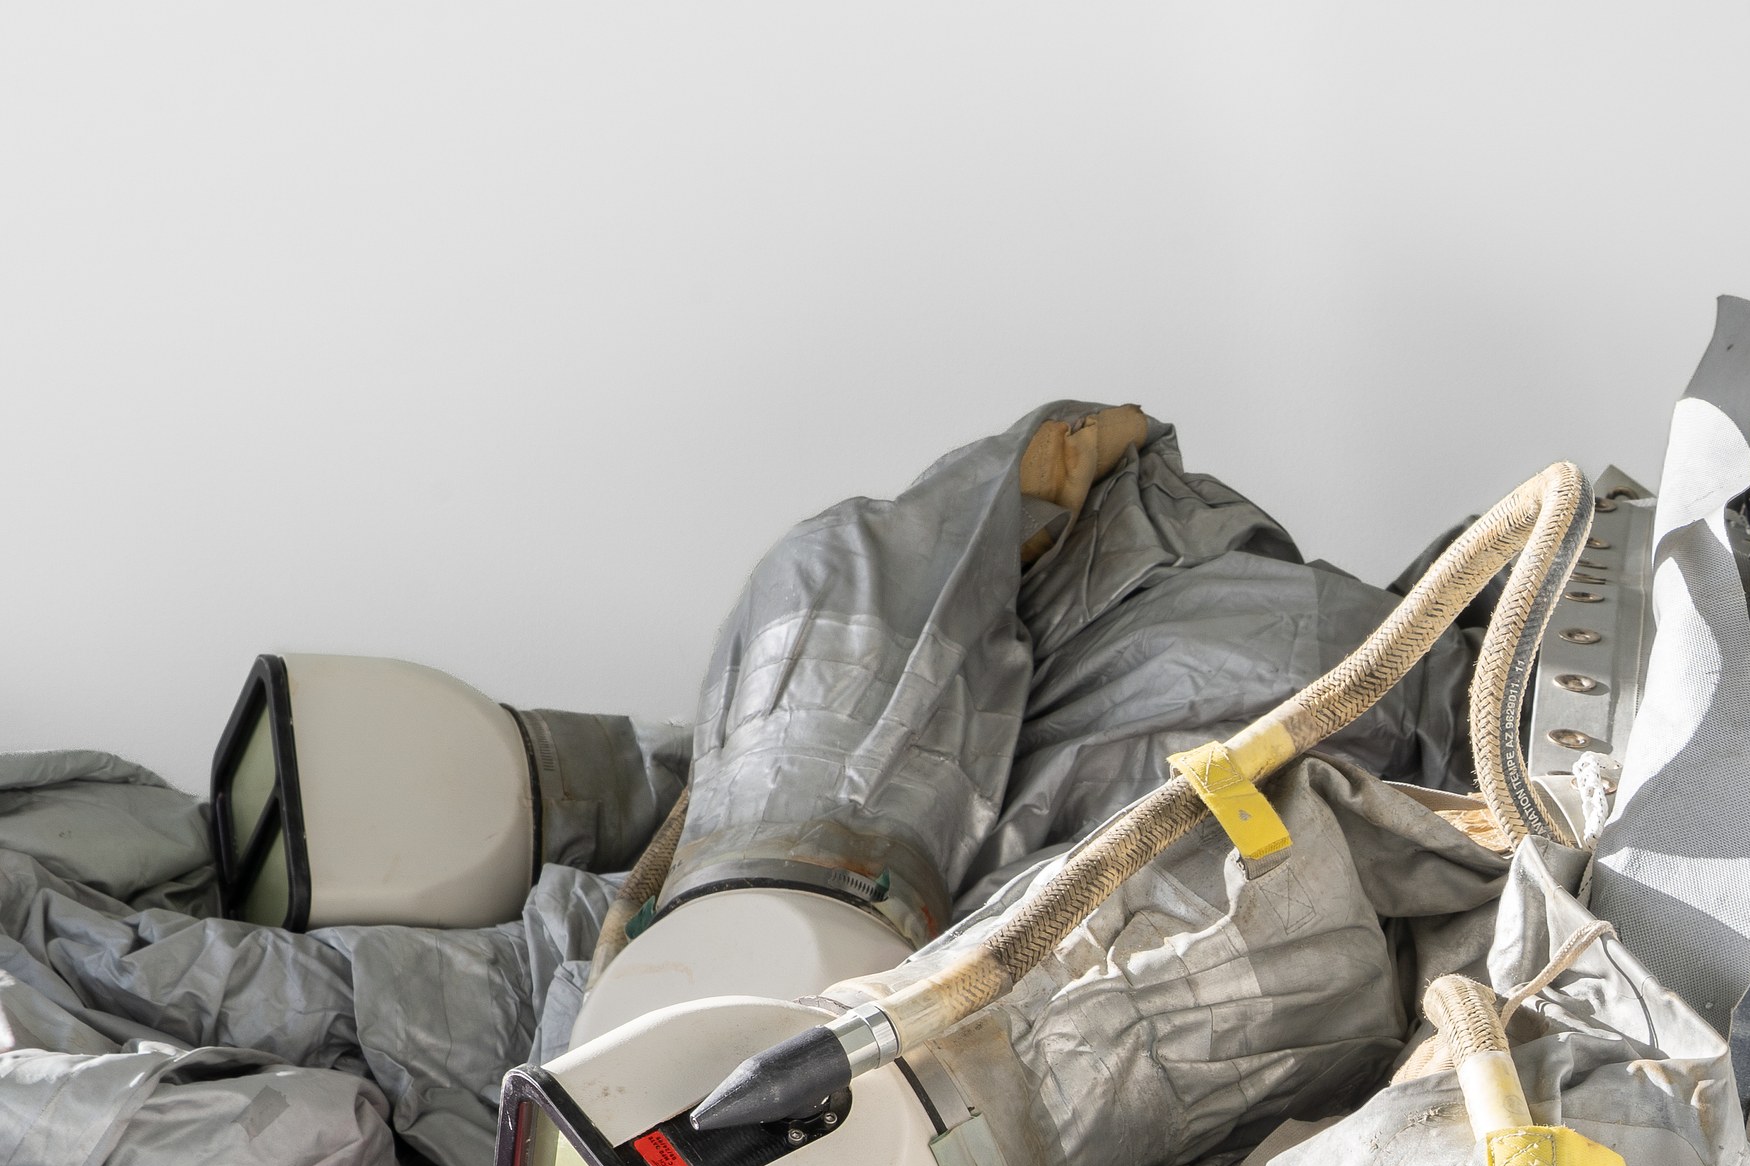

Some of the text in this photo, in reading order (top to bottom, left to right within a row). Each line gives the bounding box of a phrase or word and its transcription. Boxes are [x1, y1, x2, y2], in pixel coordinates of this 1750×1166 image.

[1504, 731, 1514, 749] AZ
[1506, 751, 1522, 790] TEMPE
[1516, 789, 1545, 836] AVIATION
[648, 1136, 661, 1150] DATE
